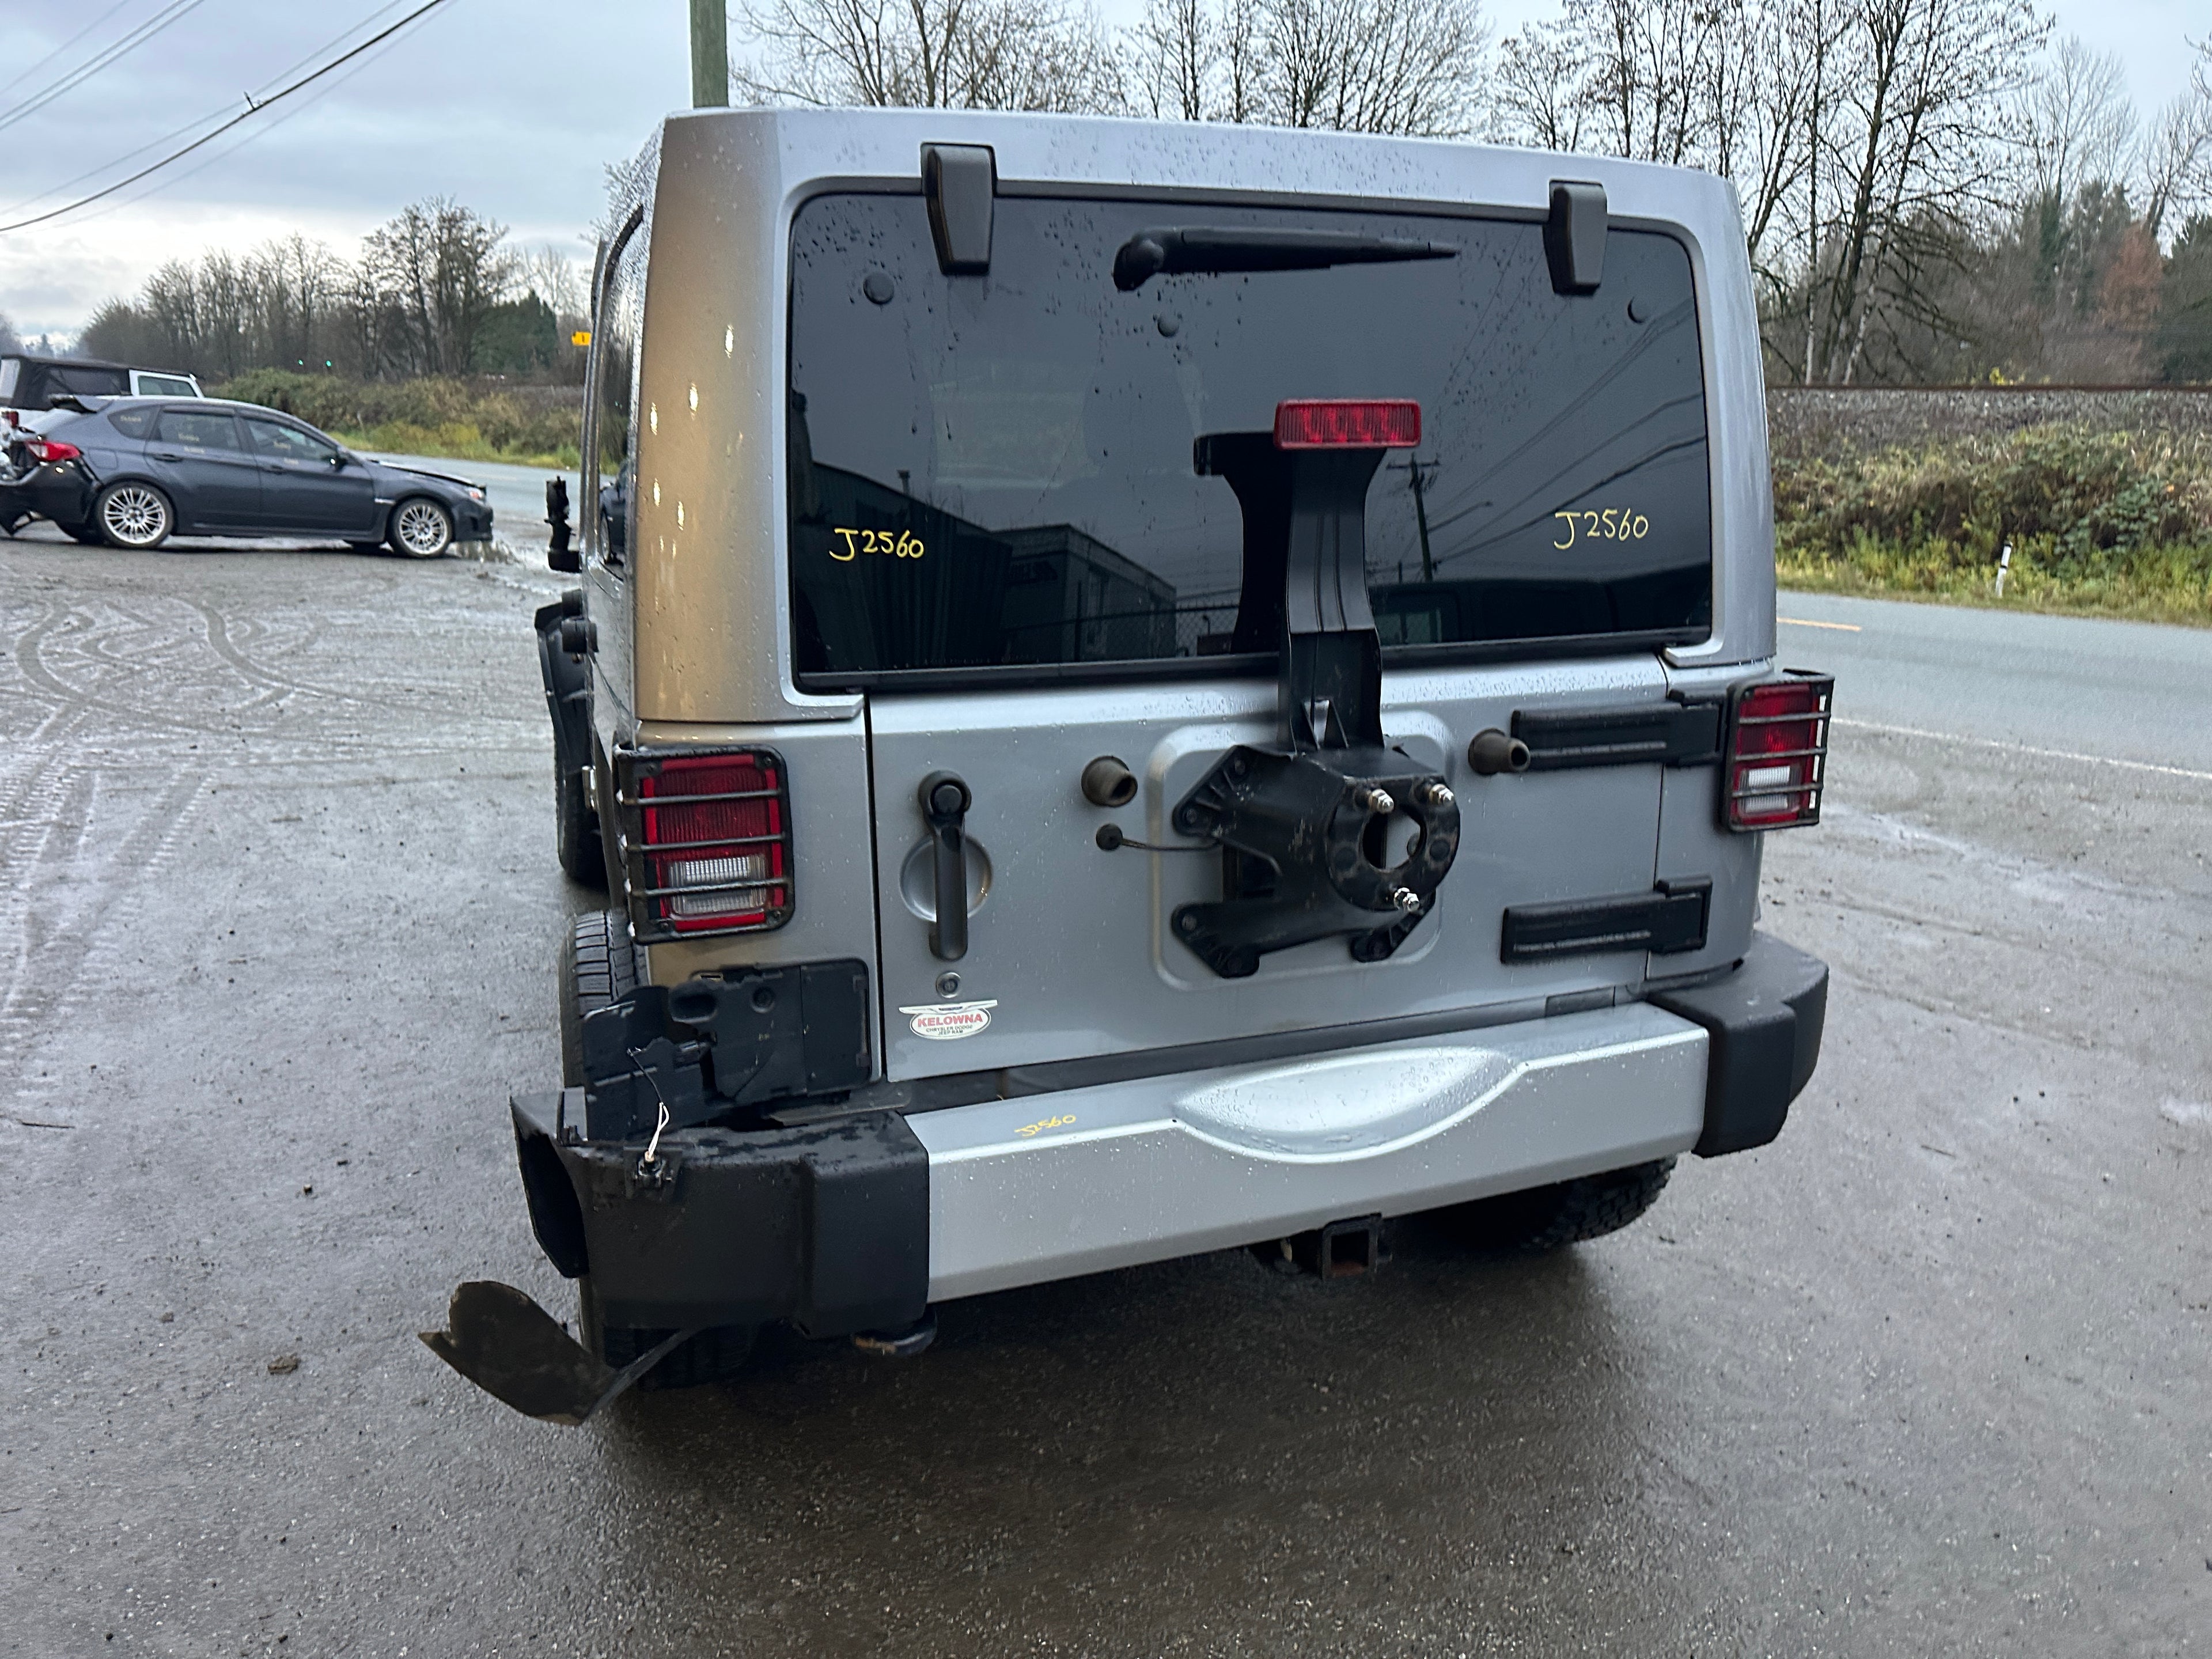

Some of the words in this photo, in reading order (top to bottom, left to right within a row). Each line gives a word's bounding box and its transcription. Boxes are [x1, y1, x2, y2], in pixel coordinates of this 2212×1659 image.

[828, 527, 925, 562] J2560
[1553, 507, 1649, 550] J2560
[918, 1014, 983, 1027] KELOWNA
